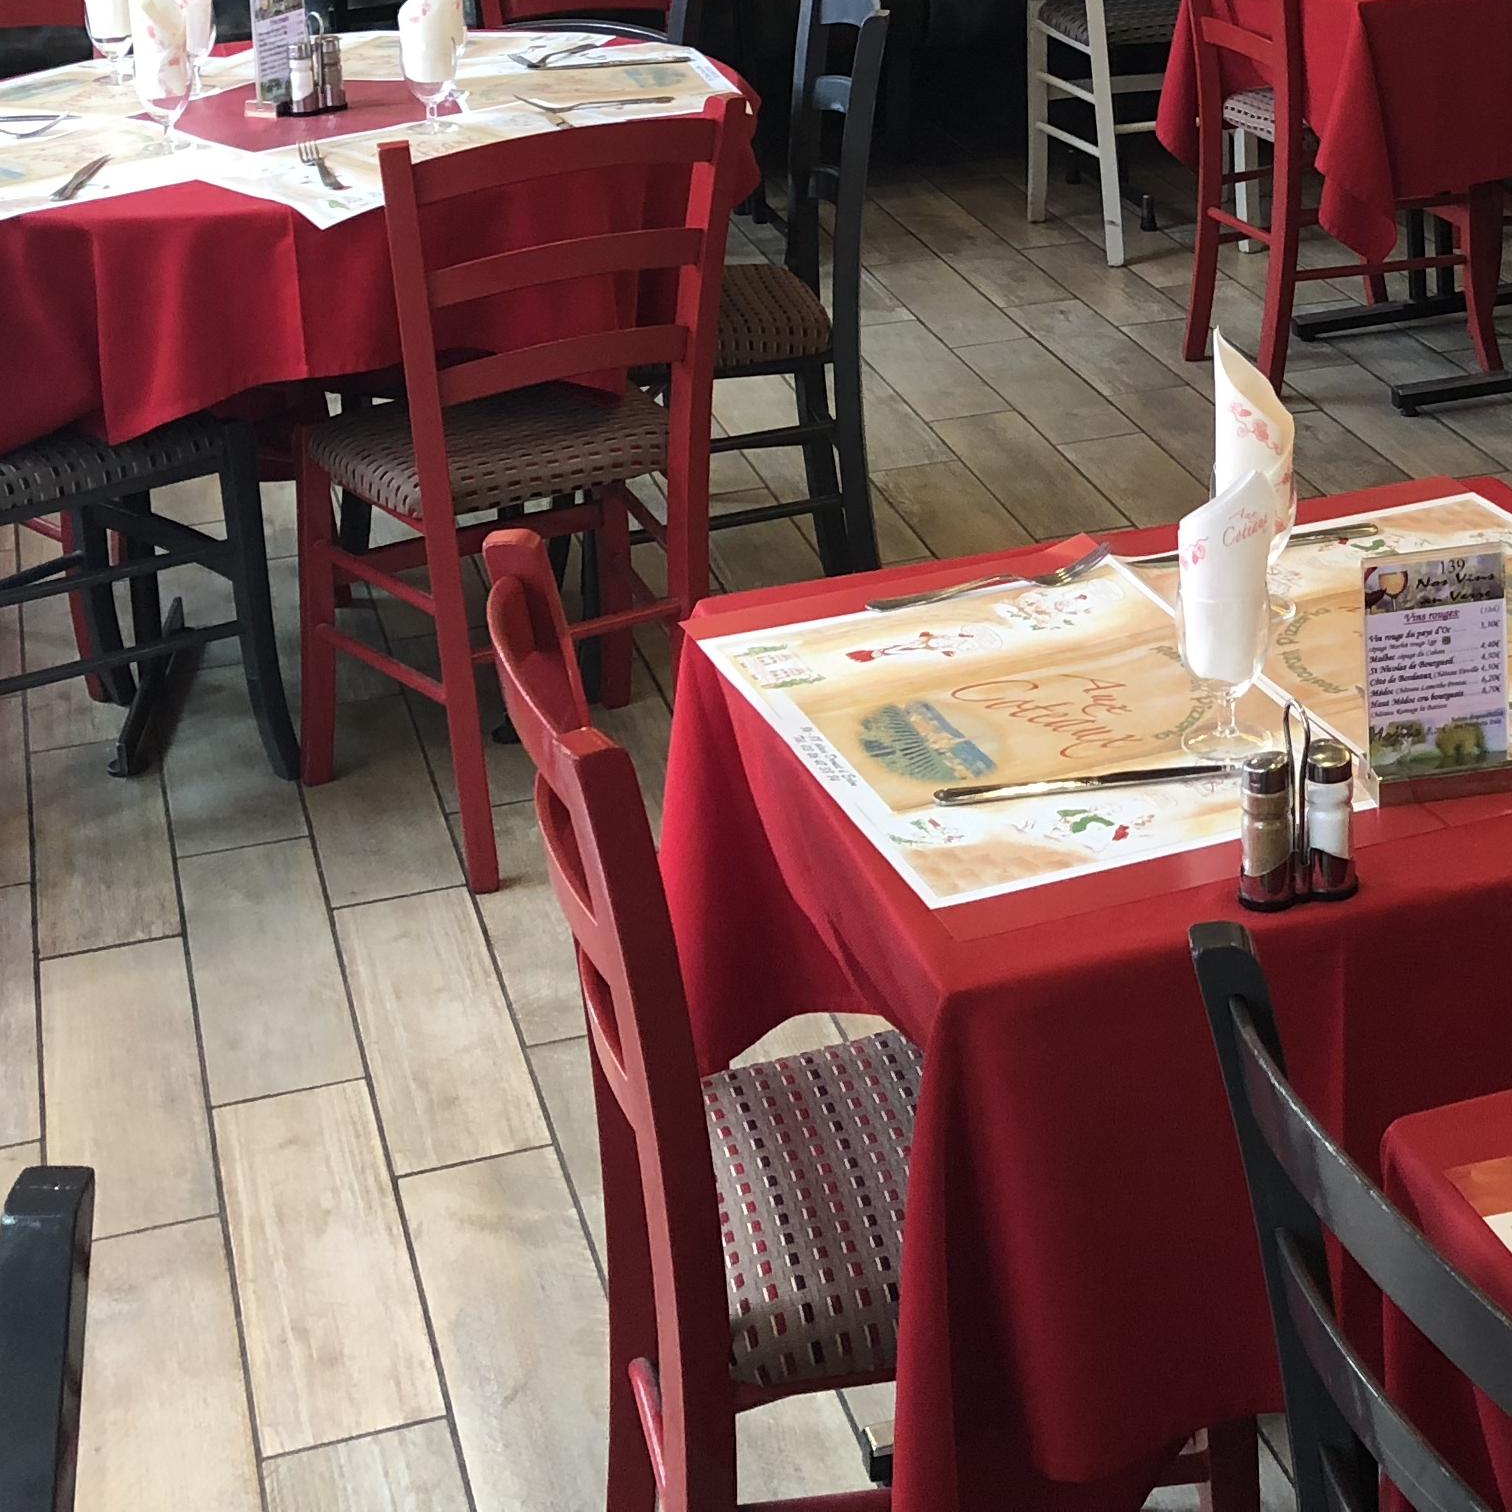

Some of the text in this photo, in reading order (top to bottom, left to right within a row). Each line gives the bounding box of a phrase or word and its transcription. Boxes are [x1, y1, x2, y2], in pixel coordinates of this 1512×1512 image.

[1440, 559, 1465, 576] 139
[1416, 572, 1496, 590] Nos Vins
[1403, 611, 1427, 625] Vins
[1058, 674, 1133, 718] Aux
[951, 679, 1144, 759] Coteaux
